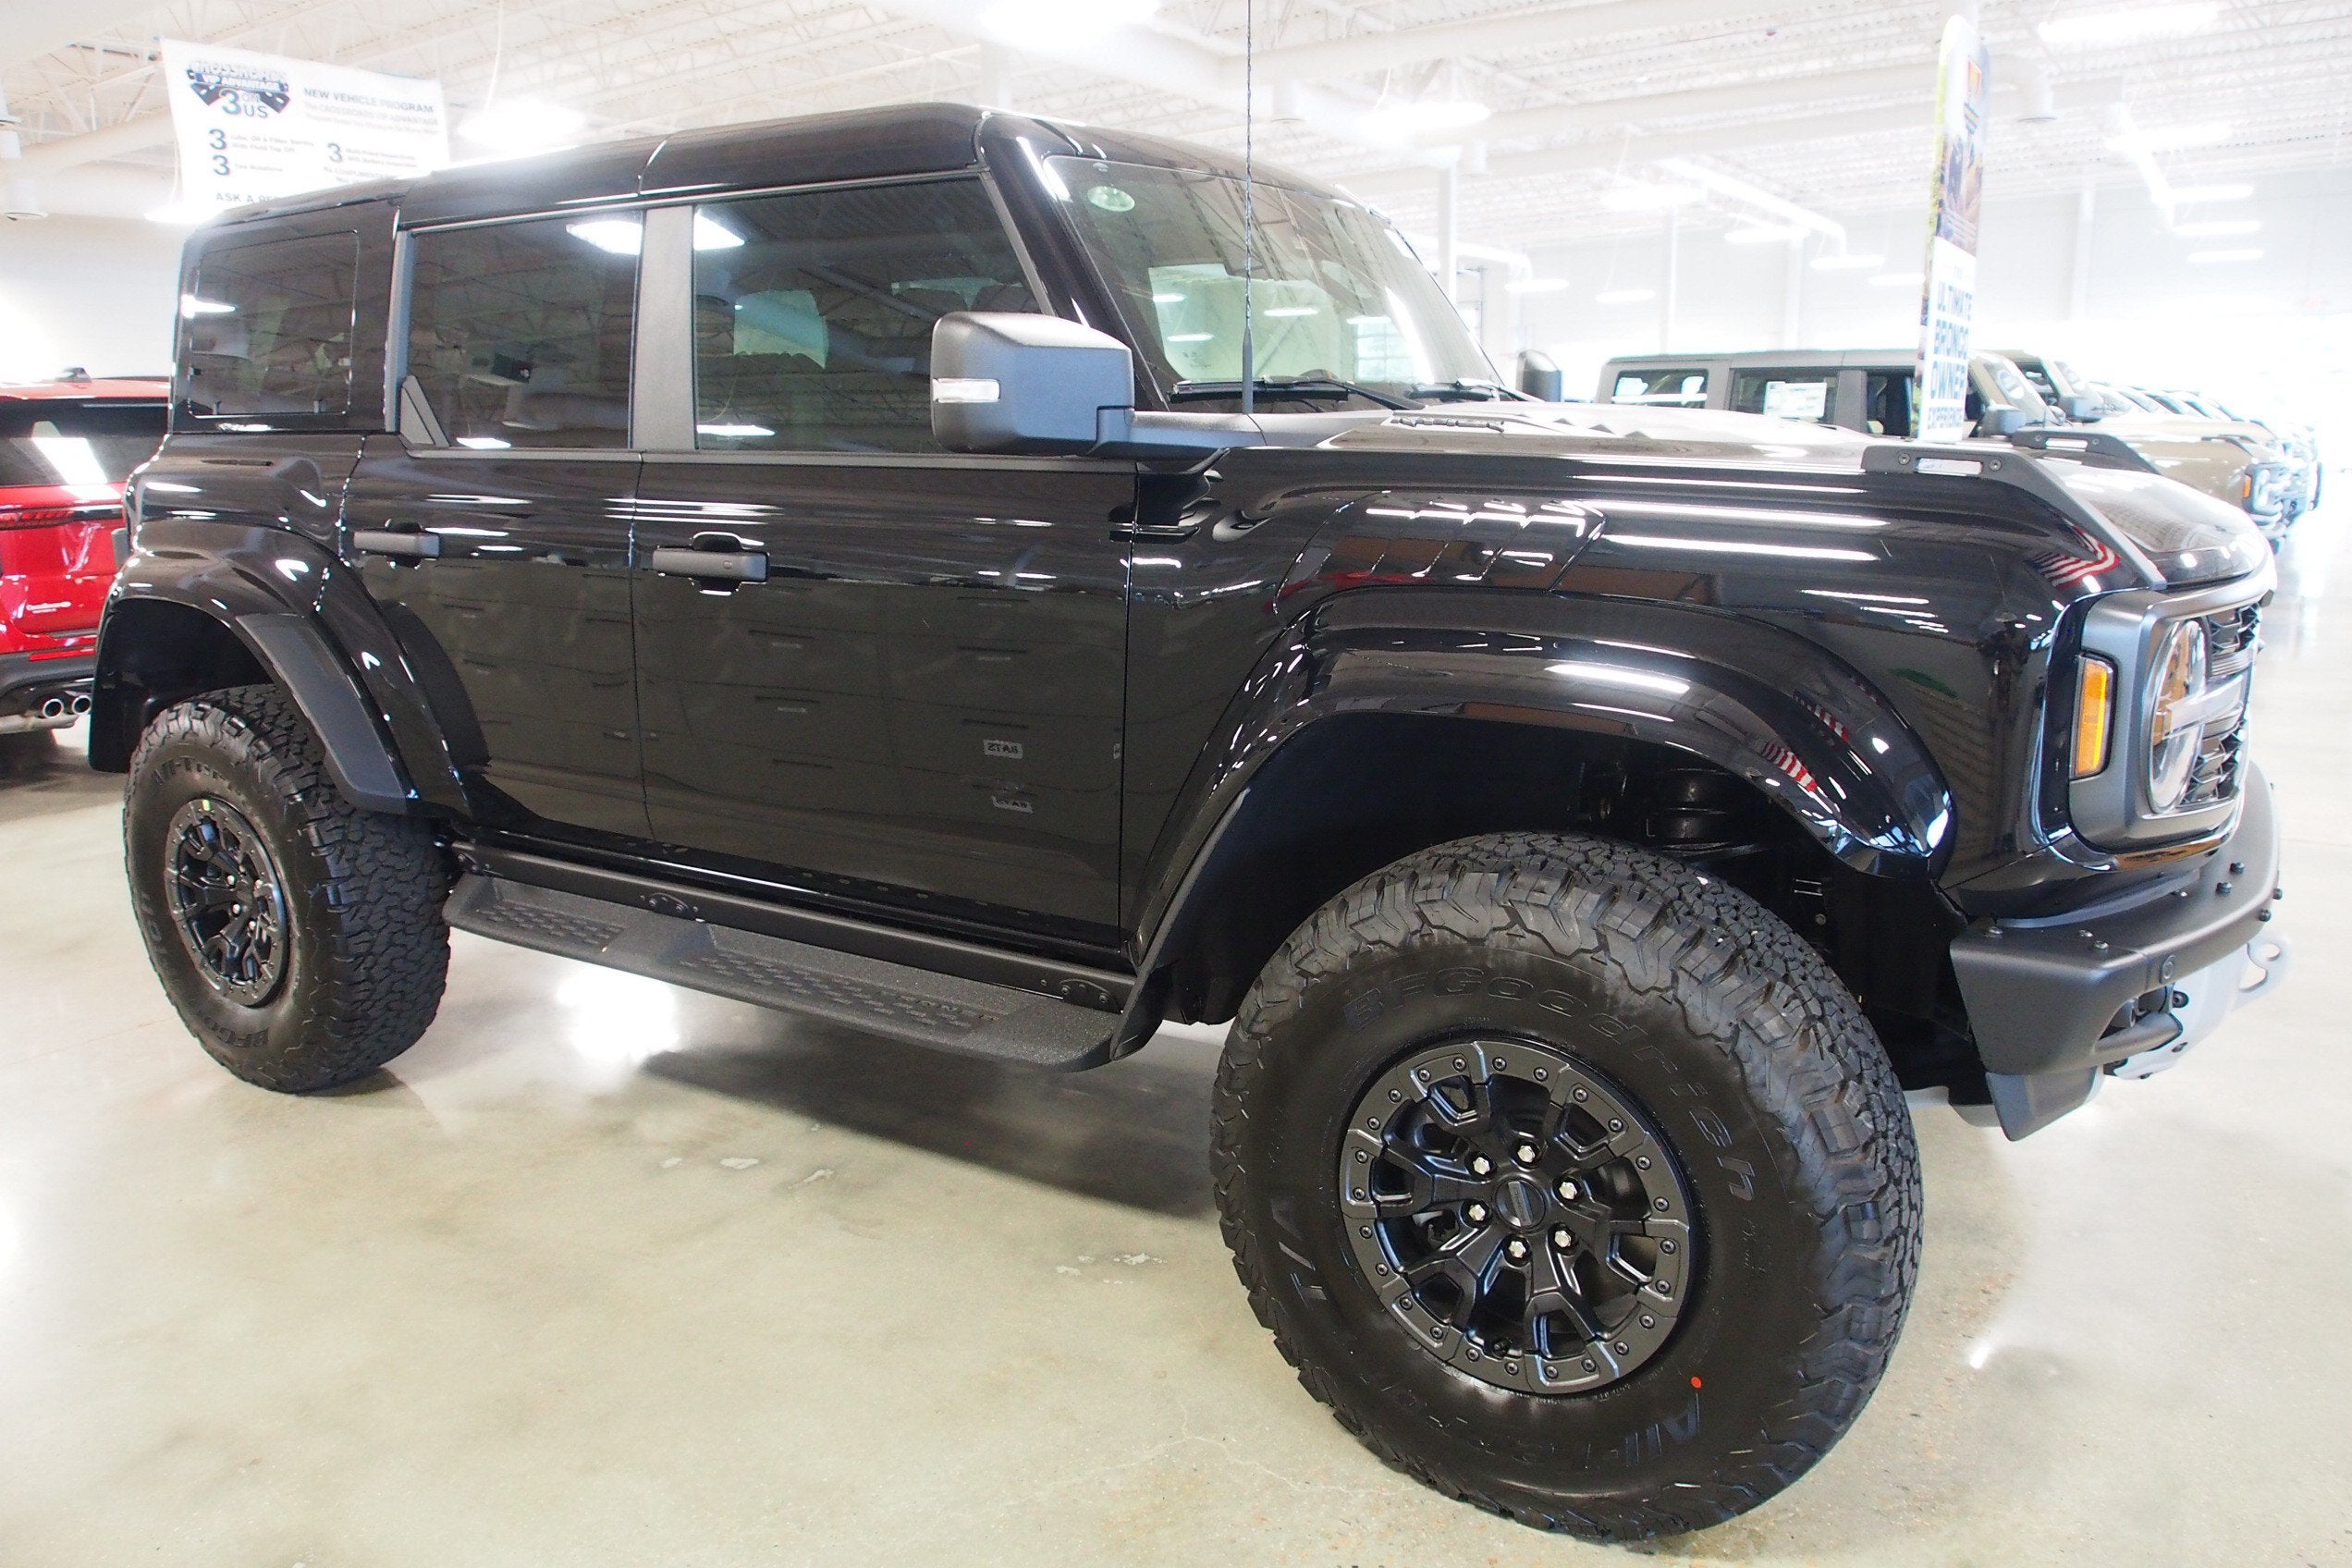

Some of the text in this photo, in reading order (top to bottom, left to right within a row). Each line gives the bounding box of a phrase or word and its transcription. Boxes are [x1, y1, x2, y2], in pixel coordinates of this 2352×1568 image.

[220, 89, 241, 116] 3
[243, 104, 268, 118] US
[303, 87, 434, 113] NEW VEHICLE PROGRAM
[209, 128, 227, 151] 3
[327, 142, 343, 164] 3
[213, 154, 230, 176] 3
[215, 192, 242, 202] ASK
[246, 195, 255, 204] A
[1342, 966, 1757, 1201] BFGoodrich
